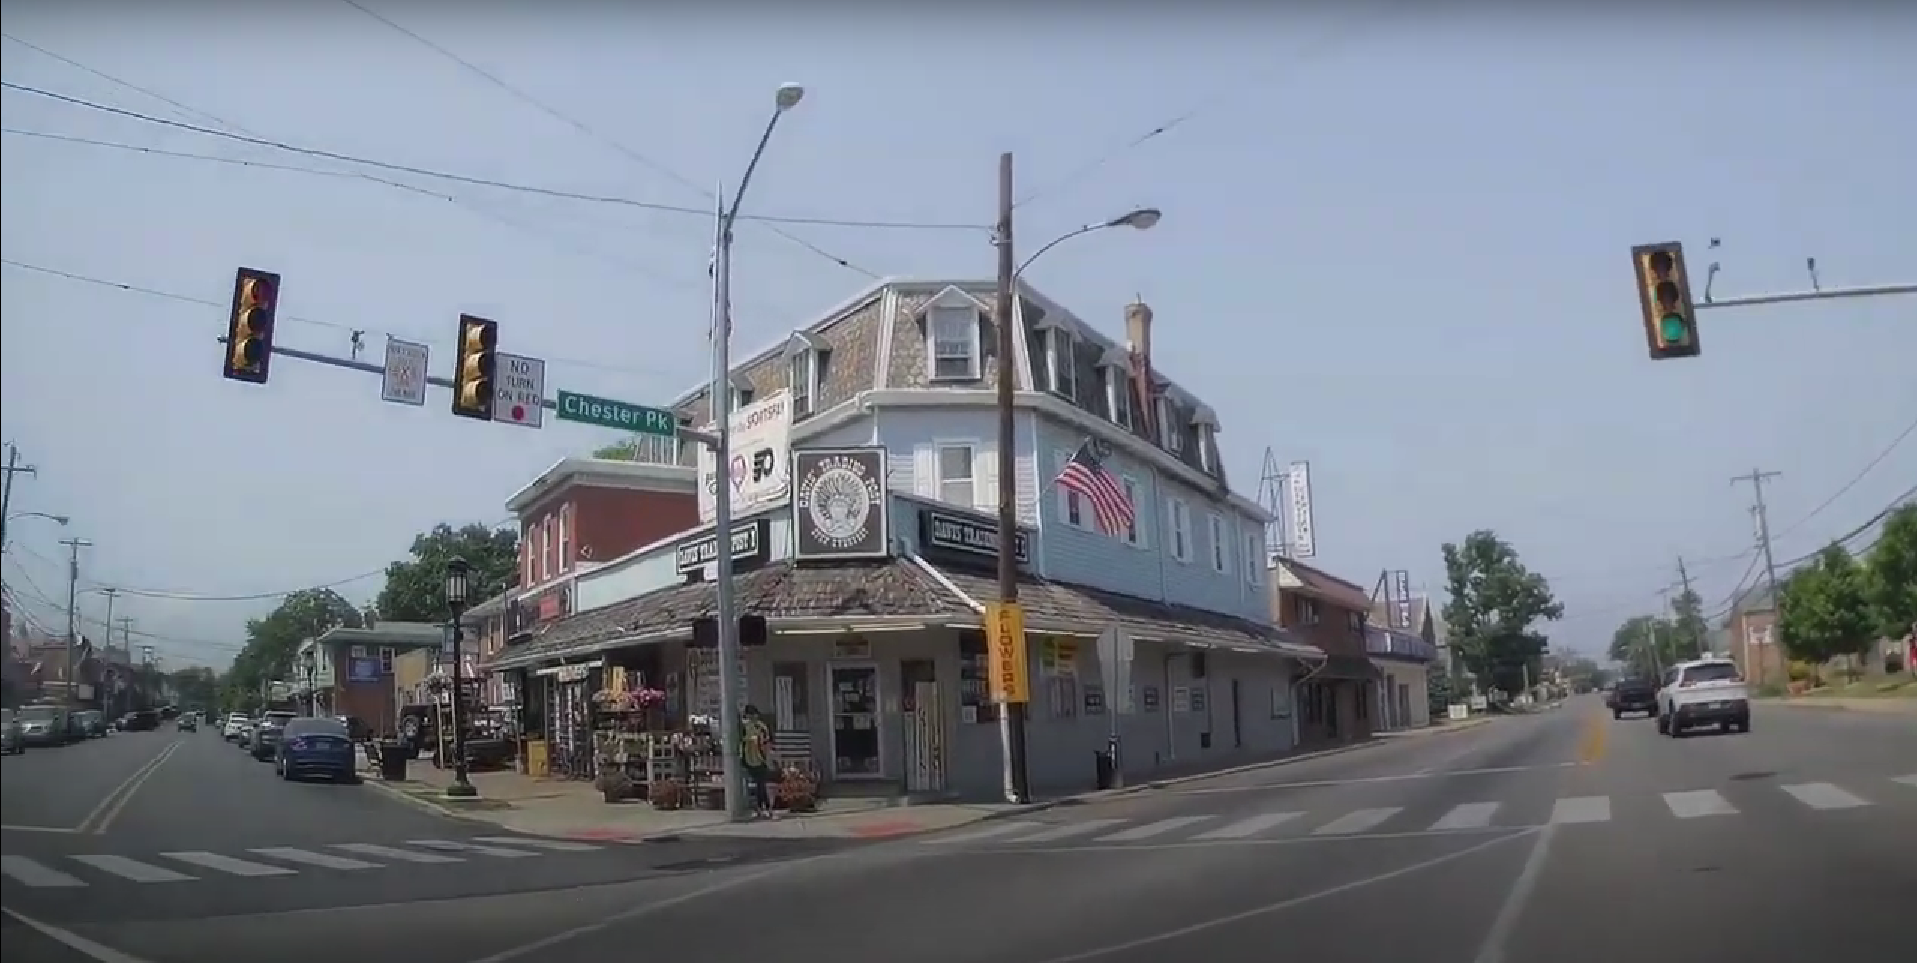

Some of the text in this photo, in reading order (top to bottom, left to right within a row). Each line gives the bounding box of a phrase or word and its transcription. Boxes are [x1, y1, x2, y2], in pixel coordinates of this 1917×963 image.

[511, 360, 530, 374] NO
[506, 375, 535, 390] TURN
[499, 388, 540, 406] ON RED
[565, 396, 668, 430] Chester Pk
[818, 456, 867, 477] TRADING
[998, 608, 1016, 697] FLOWERS
